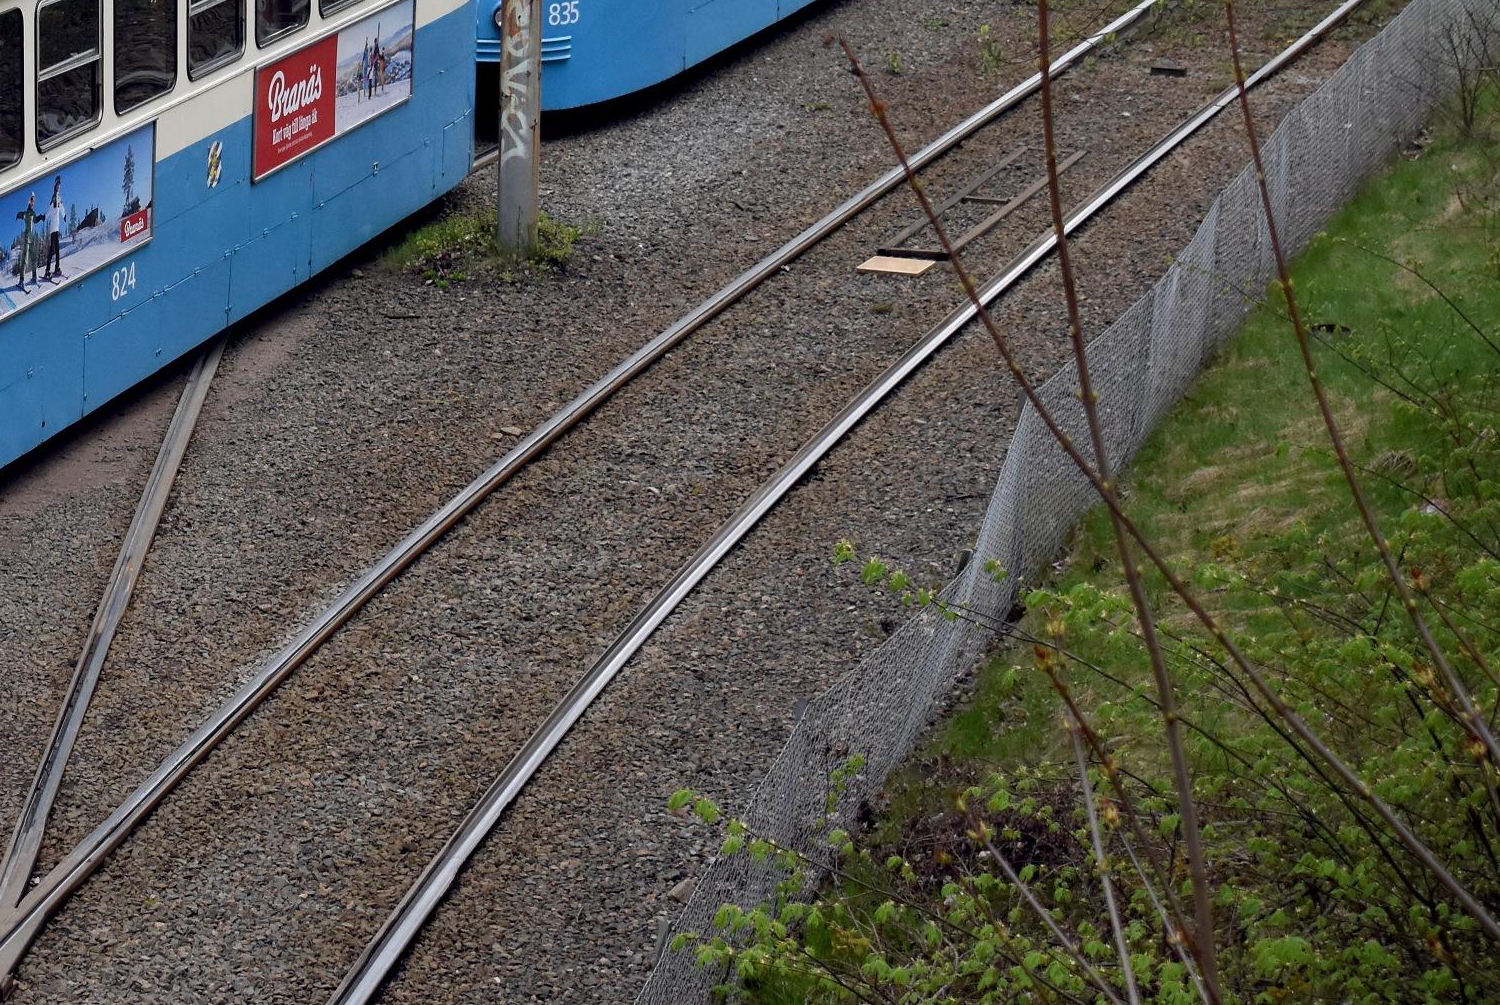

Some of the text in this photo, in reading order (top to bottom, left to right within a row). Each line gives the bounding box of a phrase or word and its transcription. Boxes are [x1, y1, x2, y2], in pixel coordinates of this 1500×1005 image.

[549, 0, 580, 26] 835
[268, 64, 322, 122] Branäs
[112, 261, 136, 301] 824
